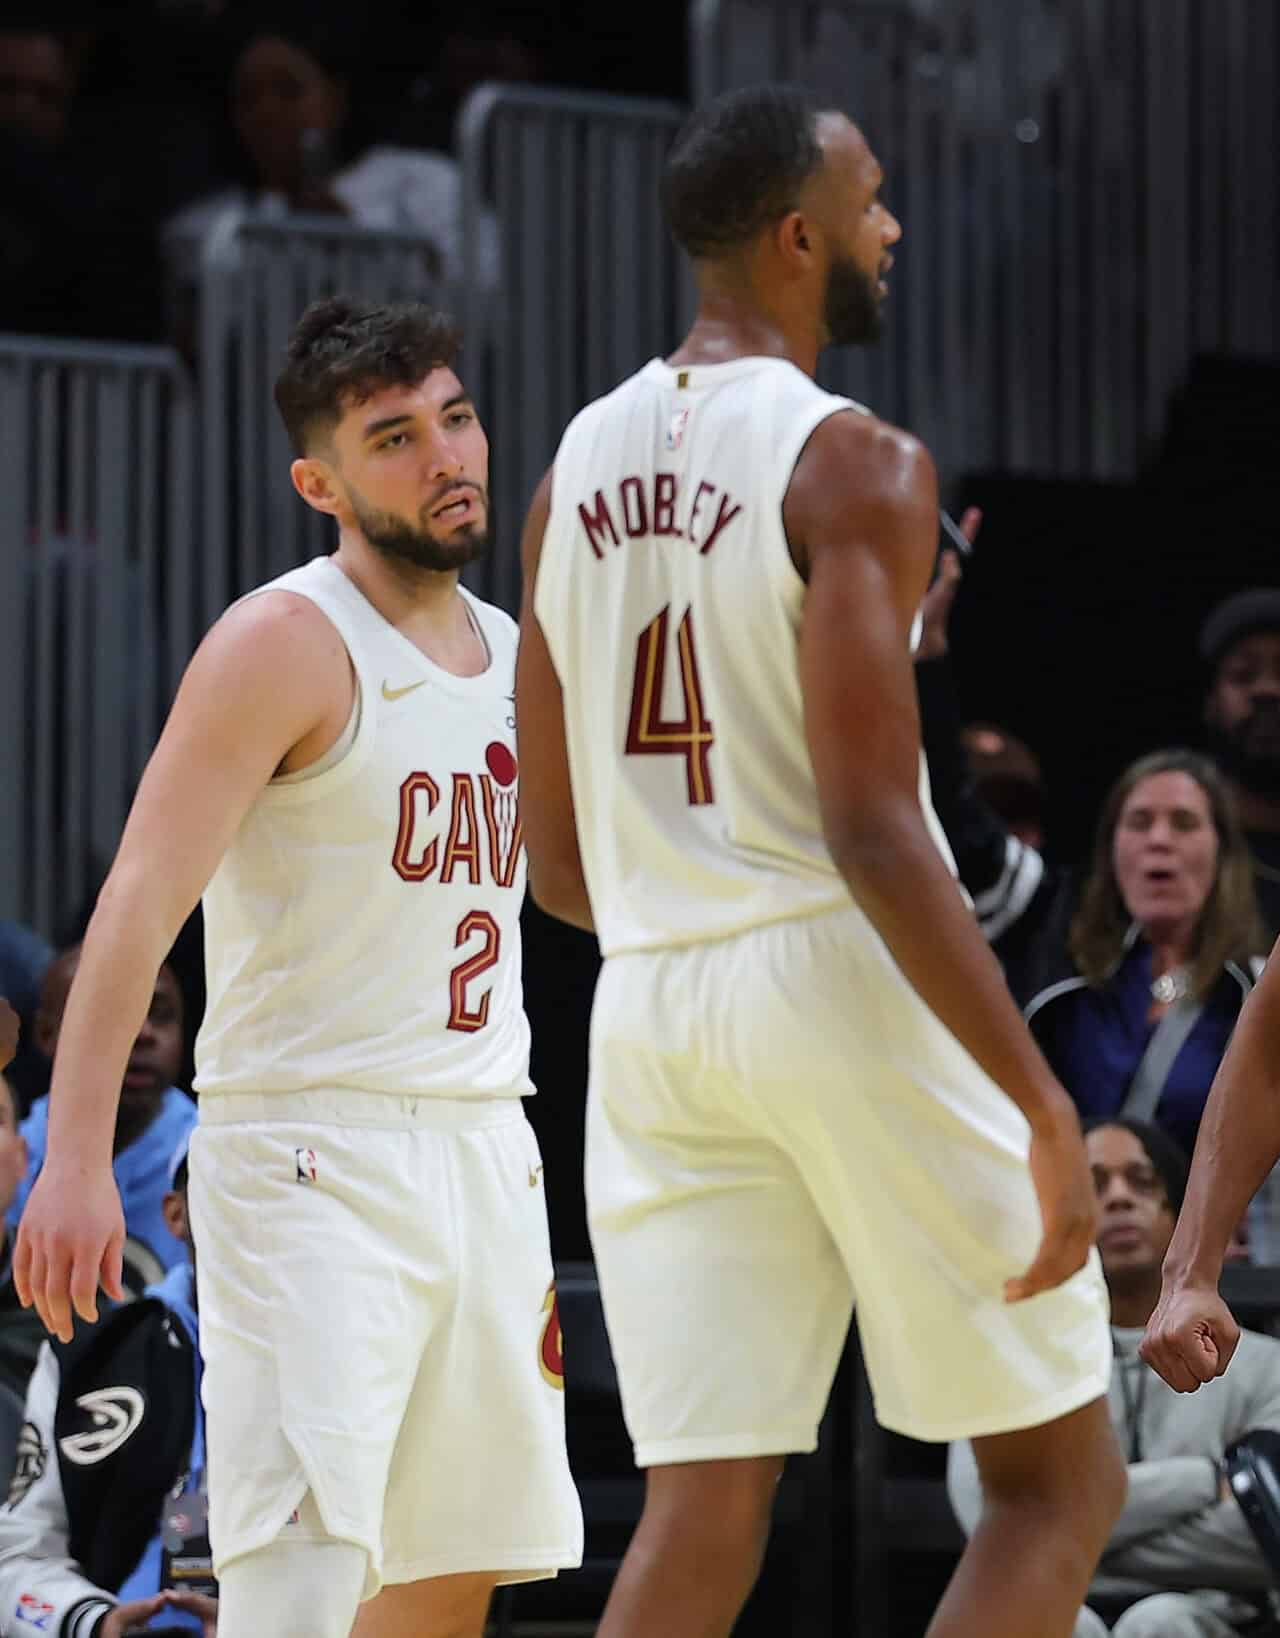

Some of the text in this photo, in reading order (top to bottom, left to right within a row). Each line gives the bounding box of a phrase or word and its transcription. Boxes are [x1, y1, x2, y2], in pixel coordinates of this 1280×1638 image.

[624, 601, 714, 806] 4
[392, 771, 524, 888] CAV
[446, 910, 500, 1033] 2
